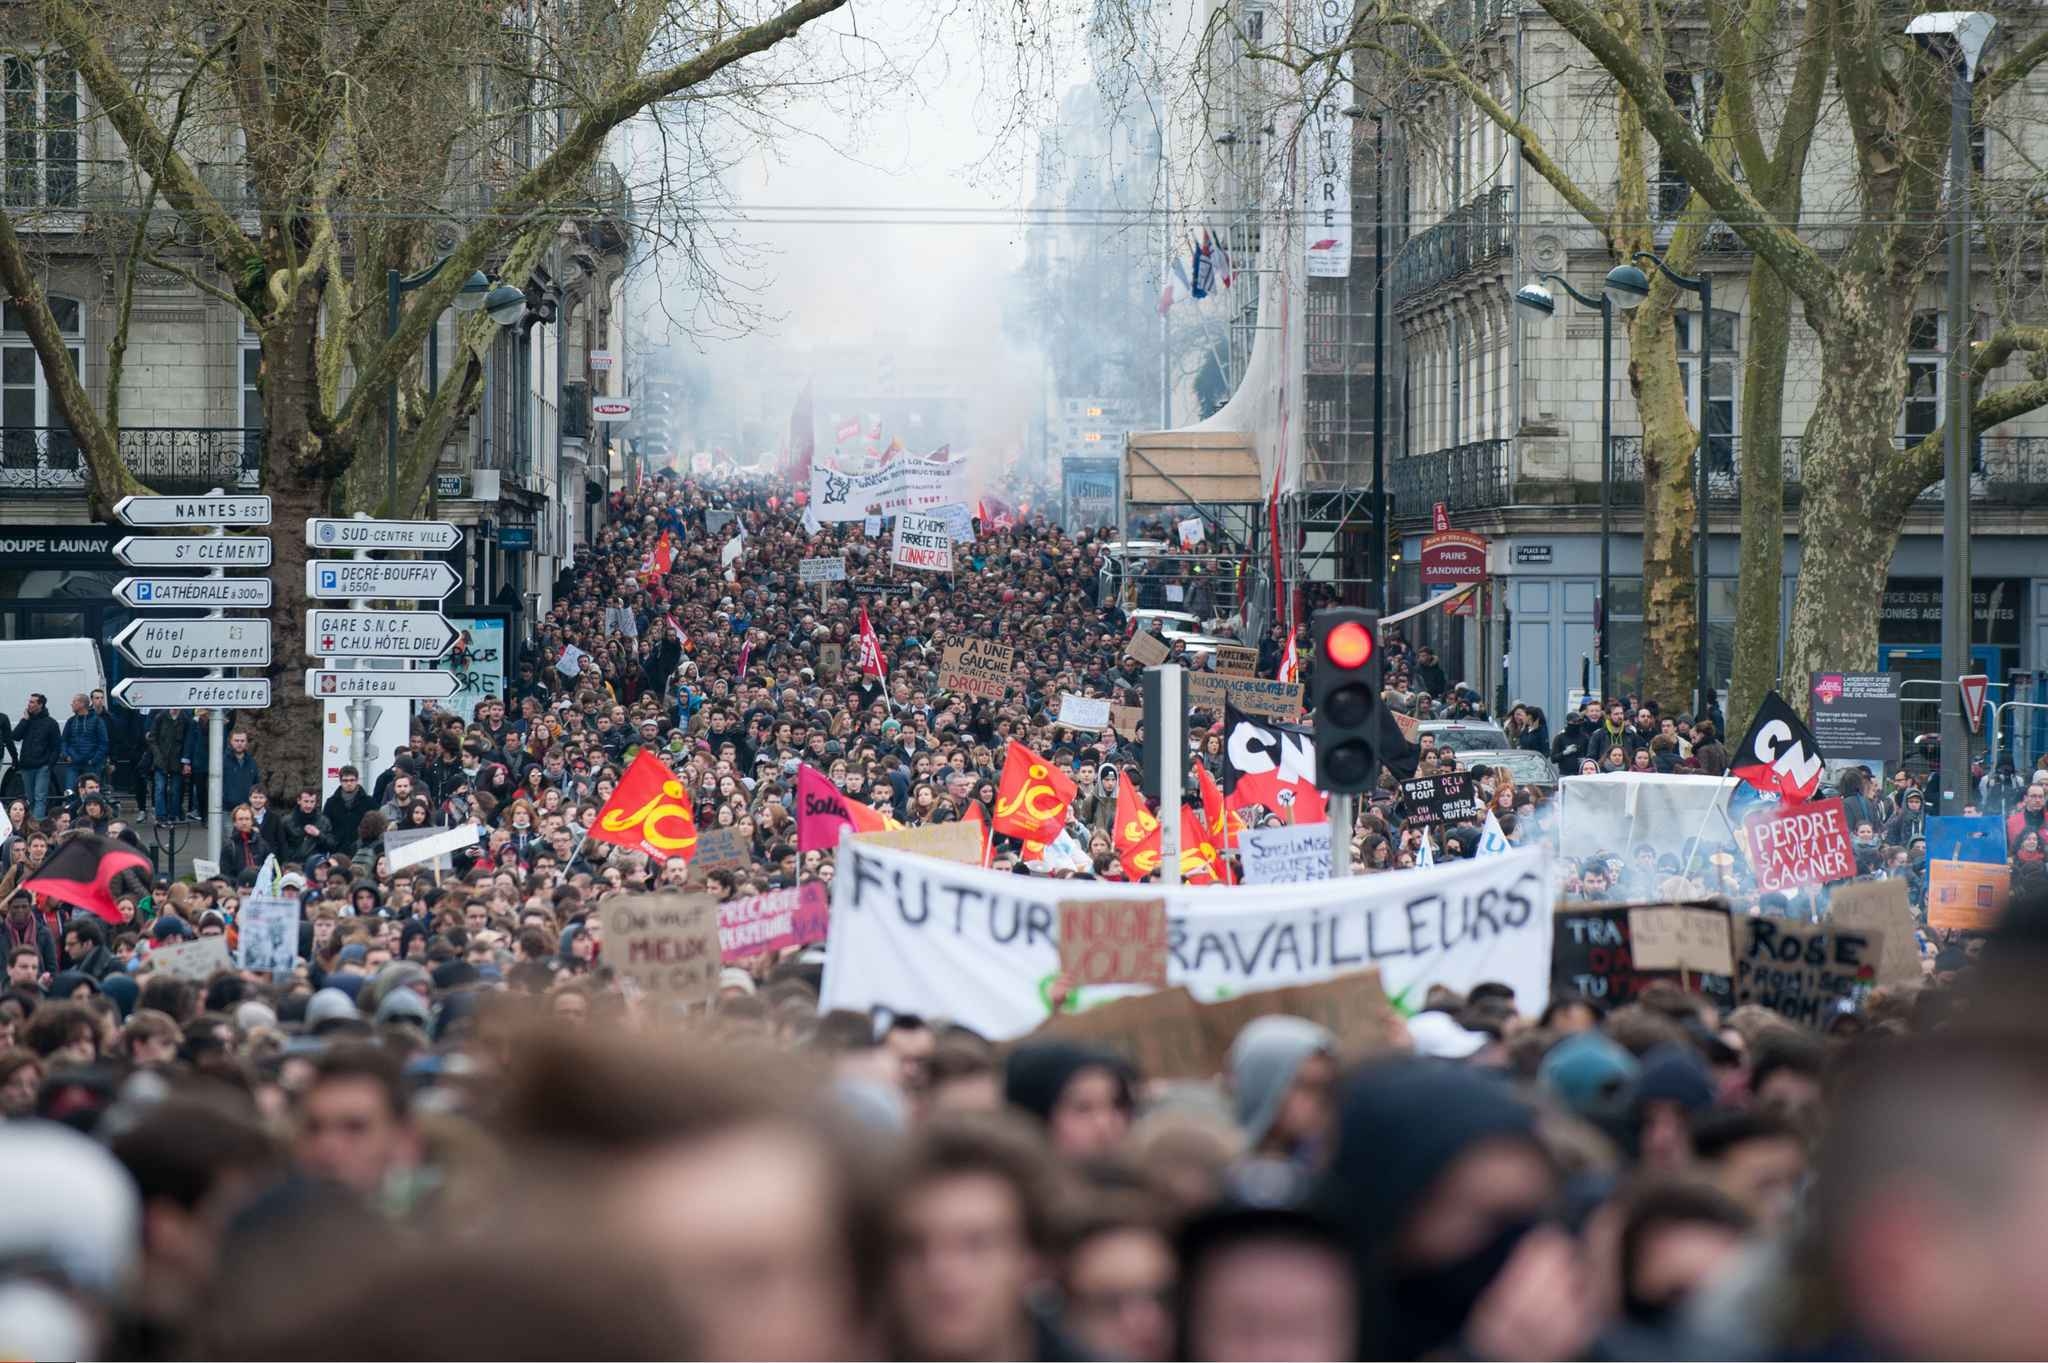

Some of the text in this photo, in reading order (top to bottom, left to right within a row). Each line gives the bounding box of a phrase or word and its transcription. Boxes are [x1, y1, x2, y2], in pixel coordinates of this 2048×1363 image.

[903, 516, 915, 530] EL
[420, 531, 448, 543] VILLE
[935, 536, 949, 549] TES
[50, 539, 109, 553] LAUNAY
[198, 543, 265, 559] CLÉMENT
[898, 546, 949, 568] CONNERIES
[1440, 551, 1467, 560] PAINS
[1424, 566, 1481, 575] SANDWICHS
[155, 584, 229, 600] CATHÉDRALE
[322, 618, 412, 633] GARE S.N.C.F.
[146, 627, 185, 641] Hôtel
[341, 633, 441, 650] C.H.U. HÔTEL DIEU
[947, 635, 1010, 660] ON A UNE
[146, 645, 264, 662] du Département
[960, 652, 1009, 674] GAUCHE
[340, 676, 397, 690] château
[949, 674, 1004, 697] DROITES
[188, 686, 265, 701] Préfecture
[1442, 776, 1464, 785] DE LA
[1412, 789, 1436, 800] FOUT
[1445, 786, 1460, 795] LOI
[1442, 802, 1454, 811] ON
[1442, 807, 1477, 819] VEUT PAS
[1755, 809, 1840, 852] PERDRE
[1760, 849, 1783, 869] SA
[1785, 840, 1810, 860] VIE
[1826, 834, 1848, 853] LA
[1762, 852, 1849, 889] GAGNER
